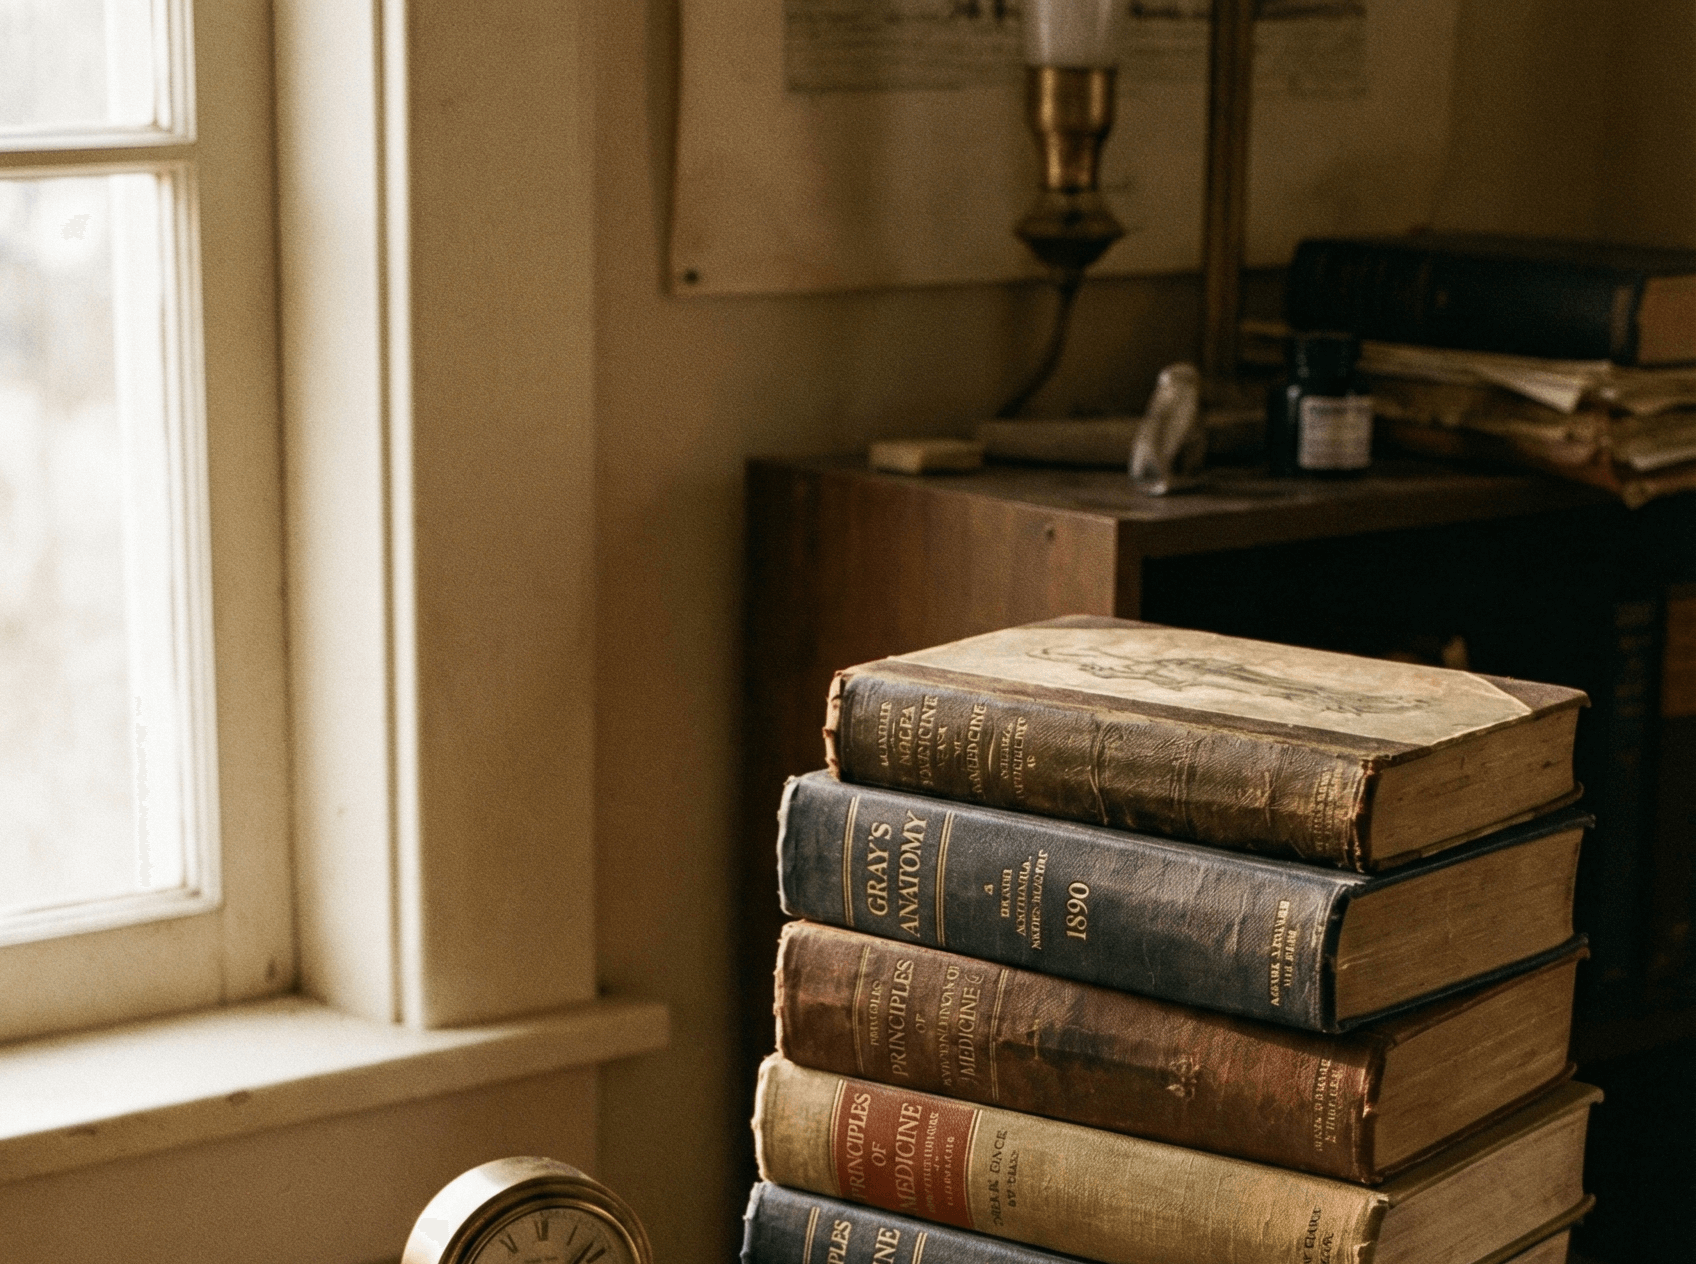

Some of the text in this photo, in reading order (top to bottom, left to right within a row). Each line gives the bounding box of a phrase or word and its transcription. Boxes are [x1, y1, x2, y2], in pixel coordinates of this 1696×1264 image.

[867, 822, 892, 917] GRAY'S
[899, 810, 927, 938] ANATOMY
[1066, 882, 1090, 941] 1890
[888, 959, 915, 1077] PRINCIPLES
[846, 1092, 872, 1200] PRINCIPLES
[871, 1141, 887, 1167] OF
[895, 1102, 923, 1212] MEDICINE
